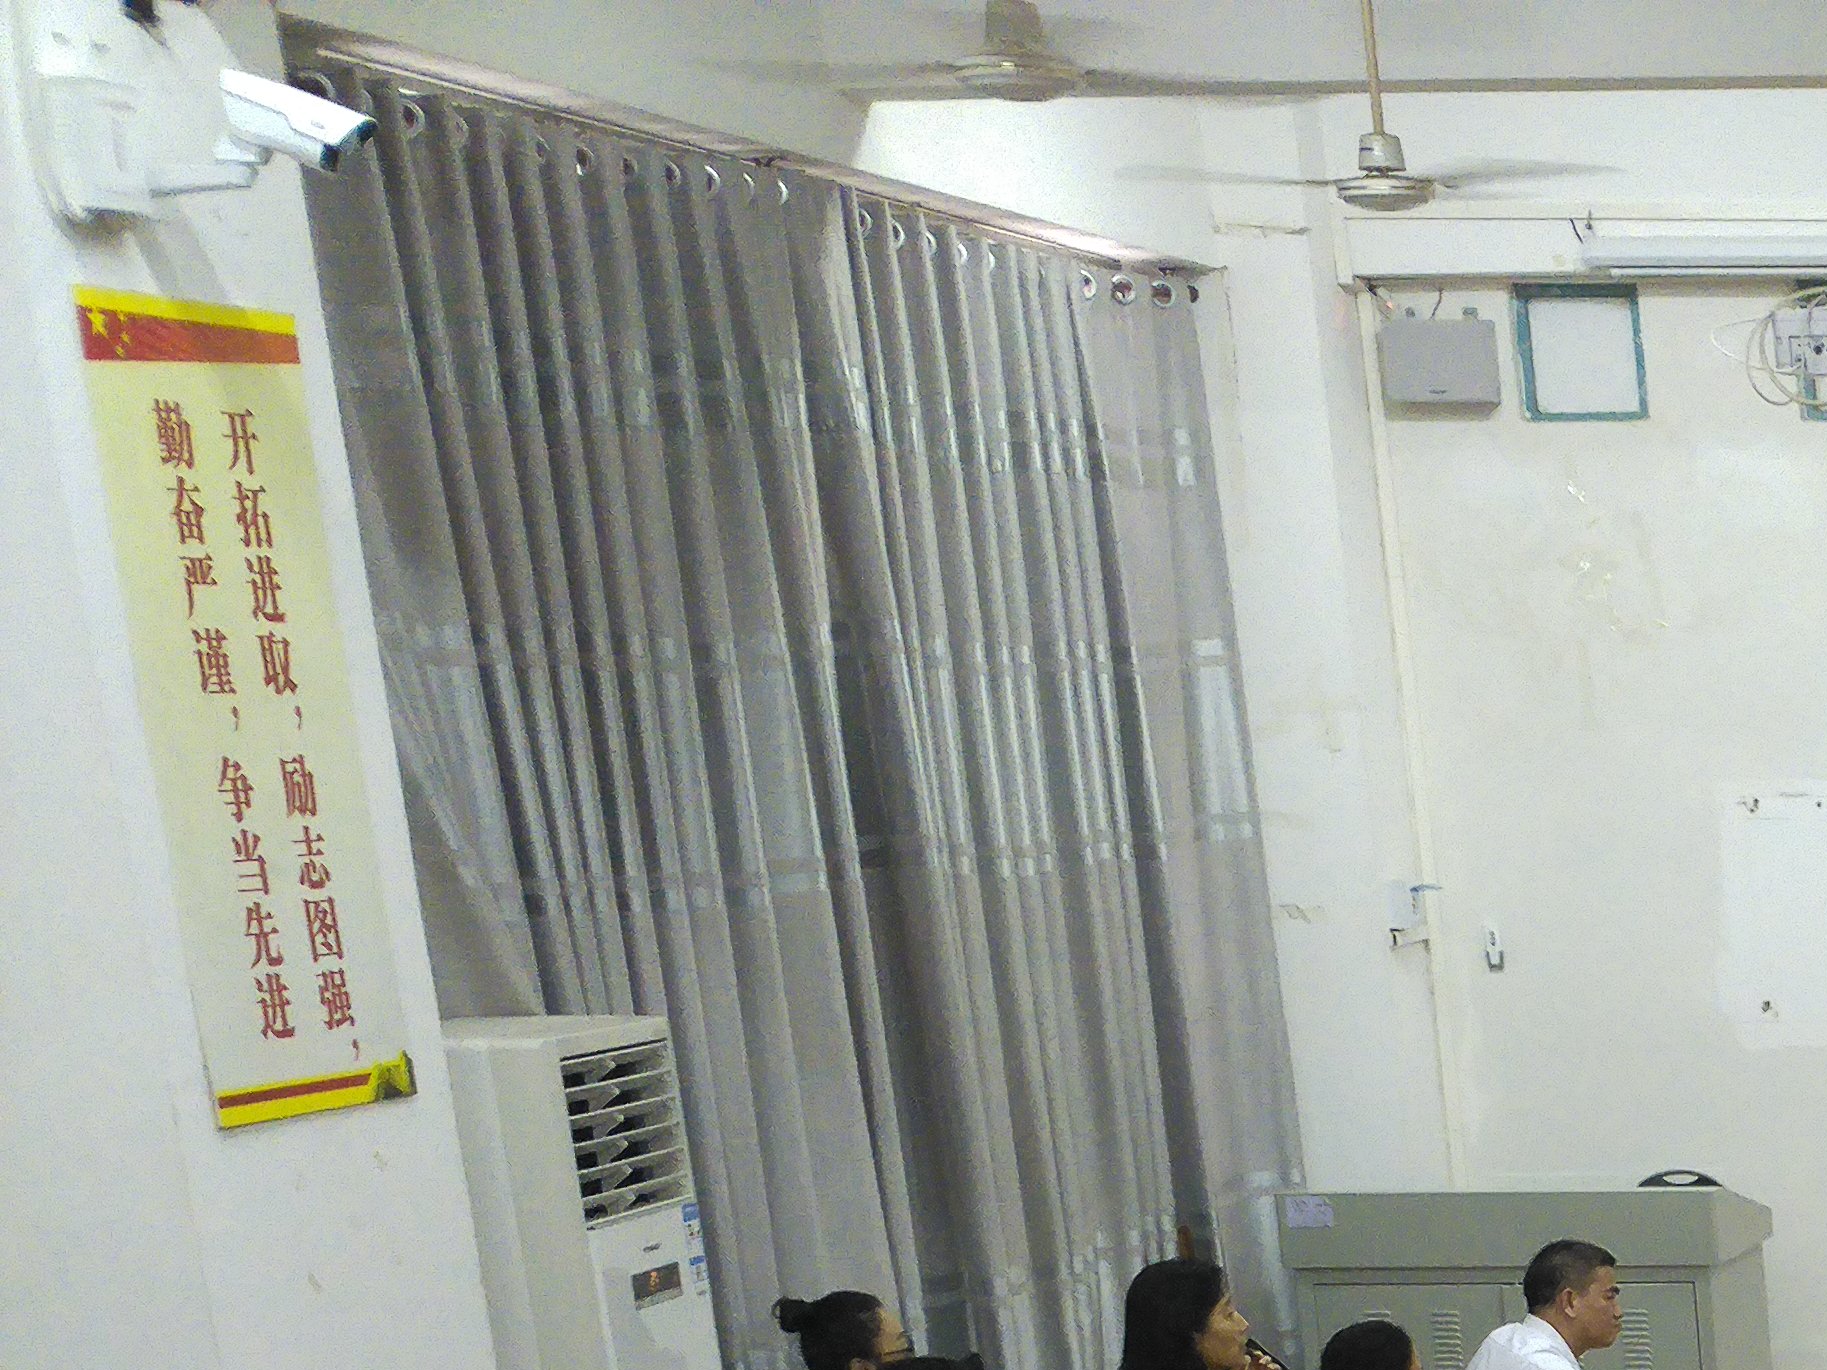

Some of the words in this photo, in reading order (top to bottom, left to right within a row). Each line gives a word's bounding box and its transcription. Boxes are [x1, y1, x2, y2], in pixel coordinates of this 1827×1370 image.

[152, 398, 295, 1041] 勤奋严谨，争当先进
